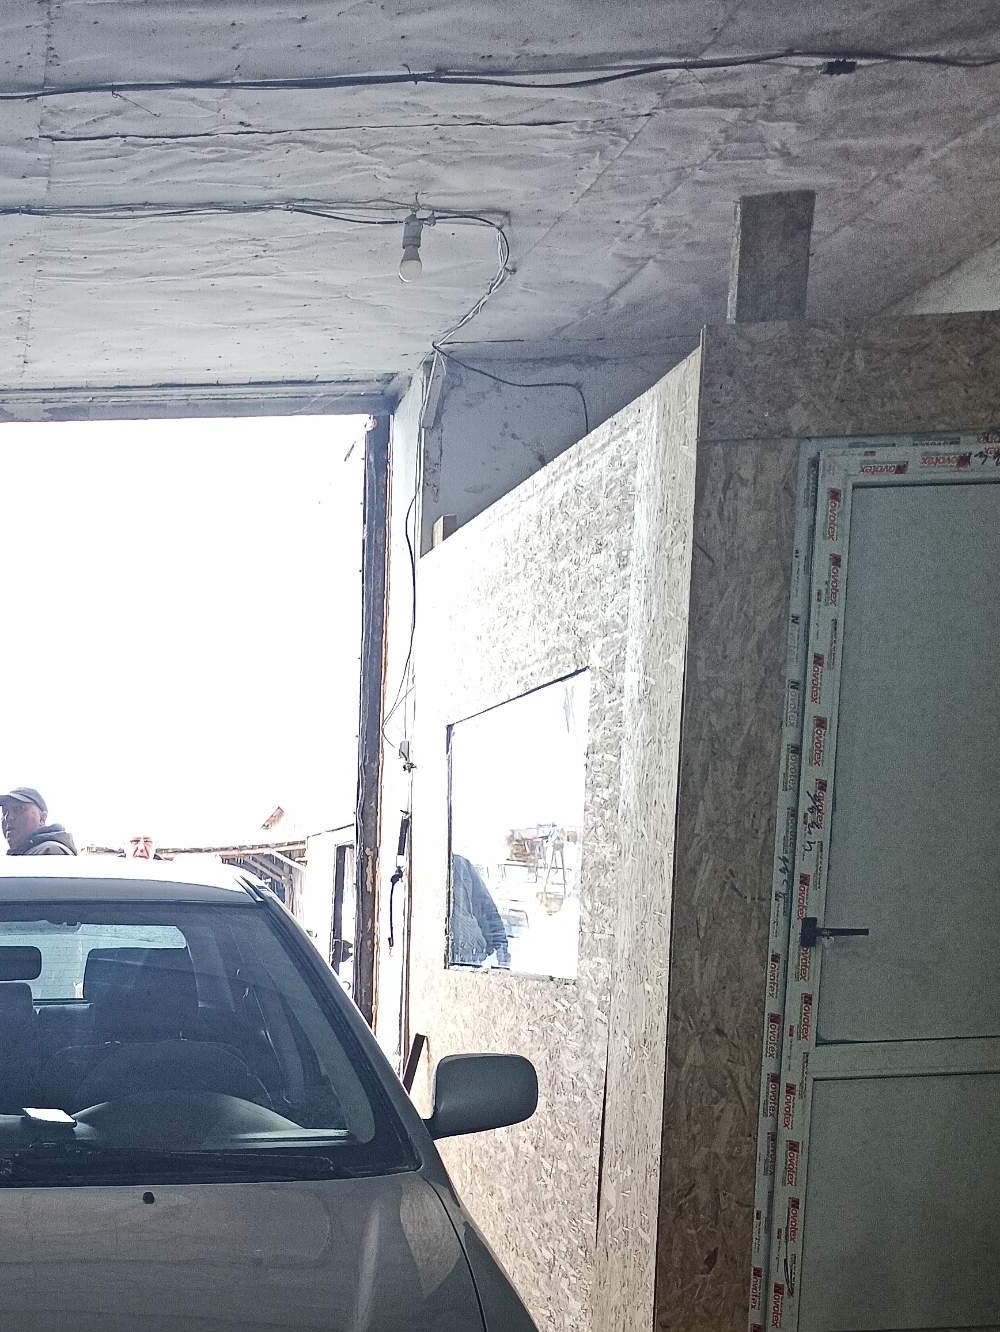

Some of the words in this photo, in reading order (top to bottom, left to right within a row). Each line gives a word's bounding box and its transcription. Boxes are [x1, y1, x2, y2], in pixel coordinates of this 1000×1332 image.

[811, 653, 825, 704] Novotex
[813, 716, 828, 767] Novotex
[801, 945, 811, 982] ovotex
[767, 1013, 781, 1059] Novotex
[783, 1083, 797, 1129] Novotex
[786, 1140, 799, 1185] Novotex
[771, 1282, 785, 1328] Novotex
